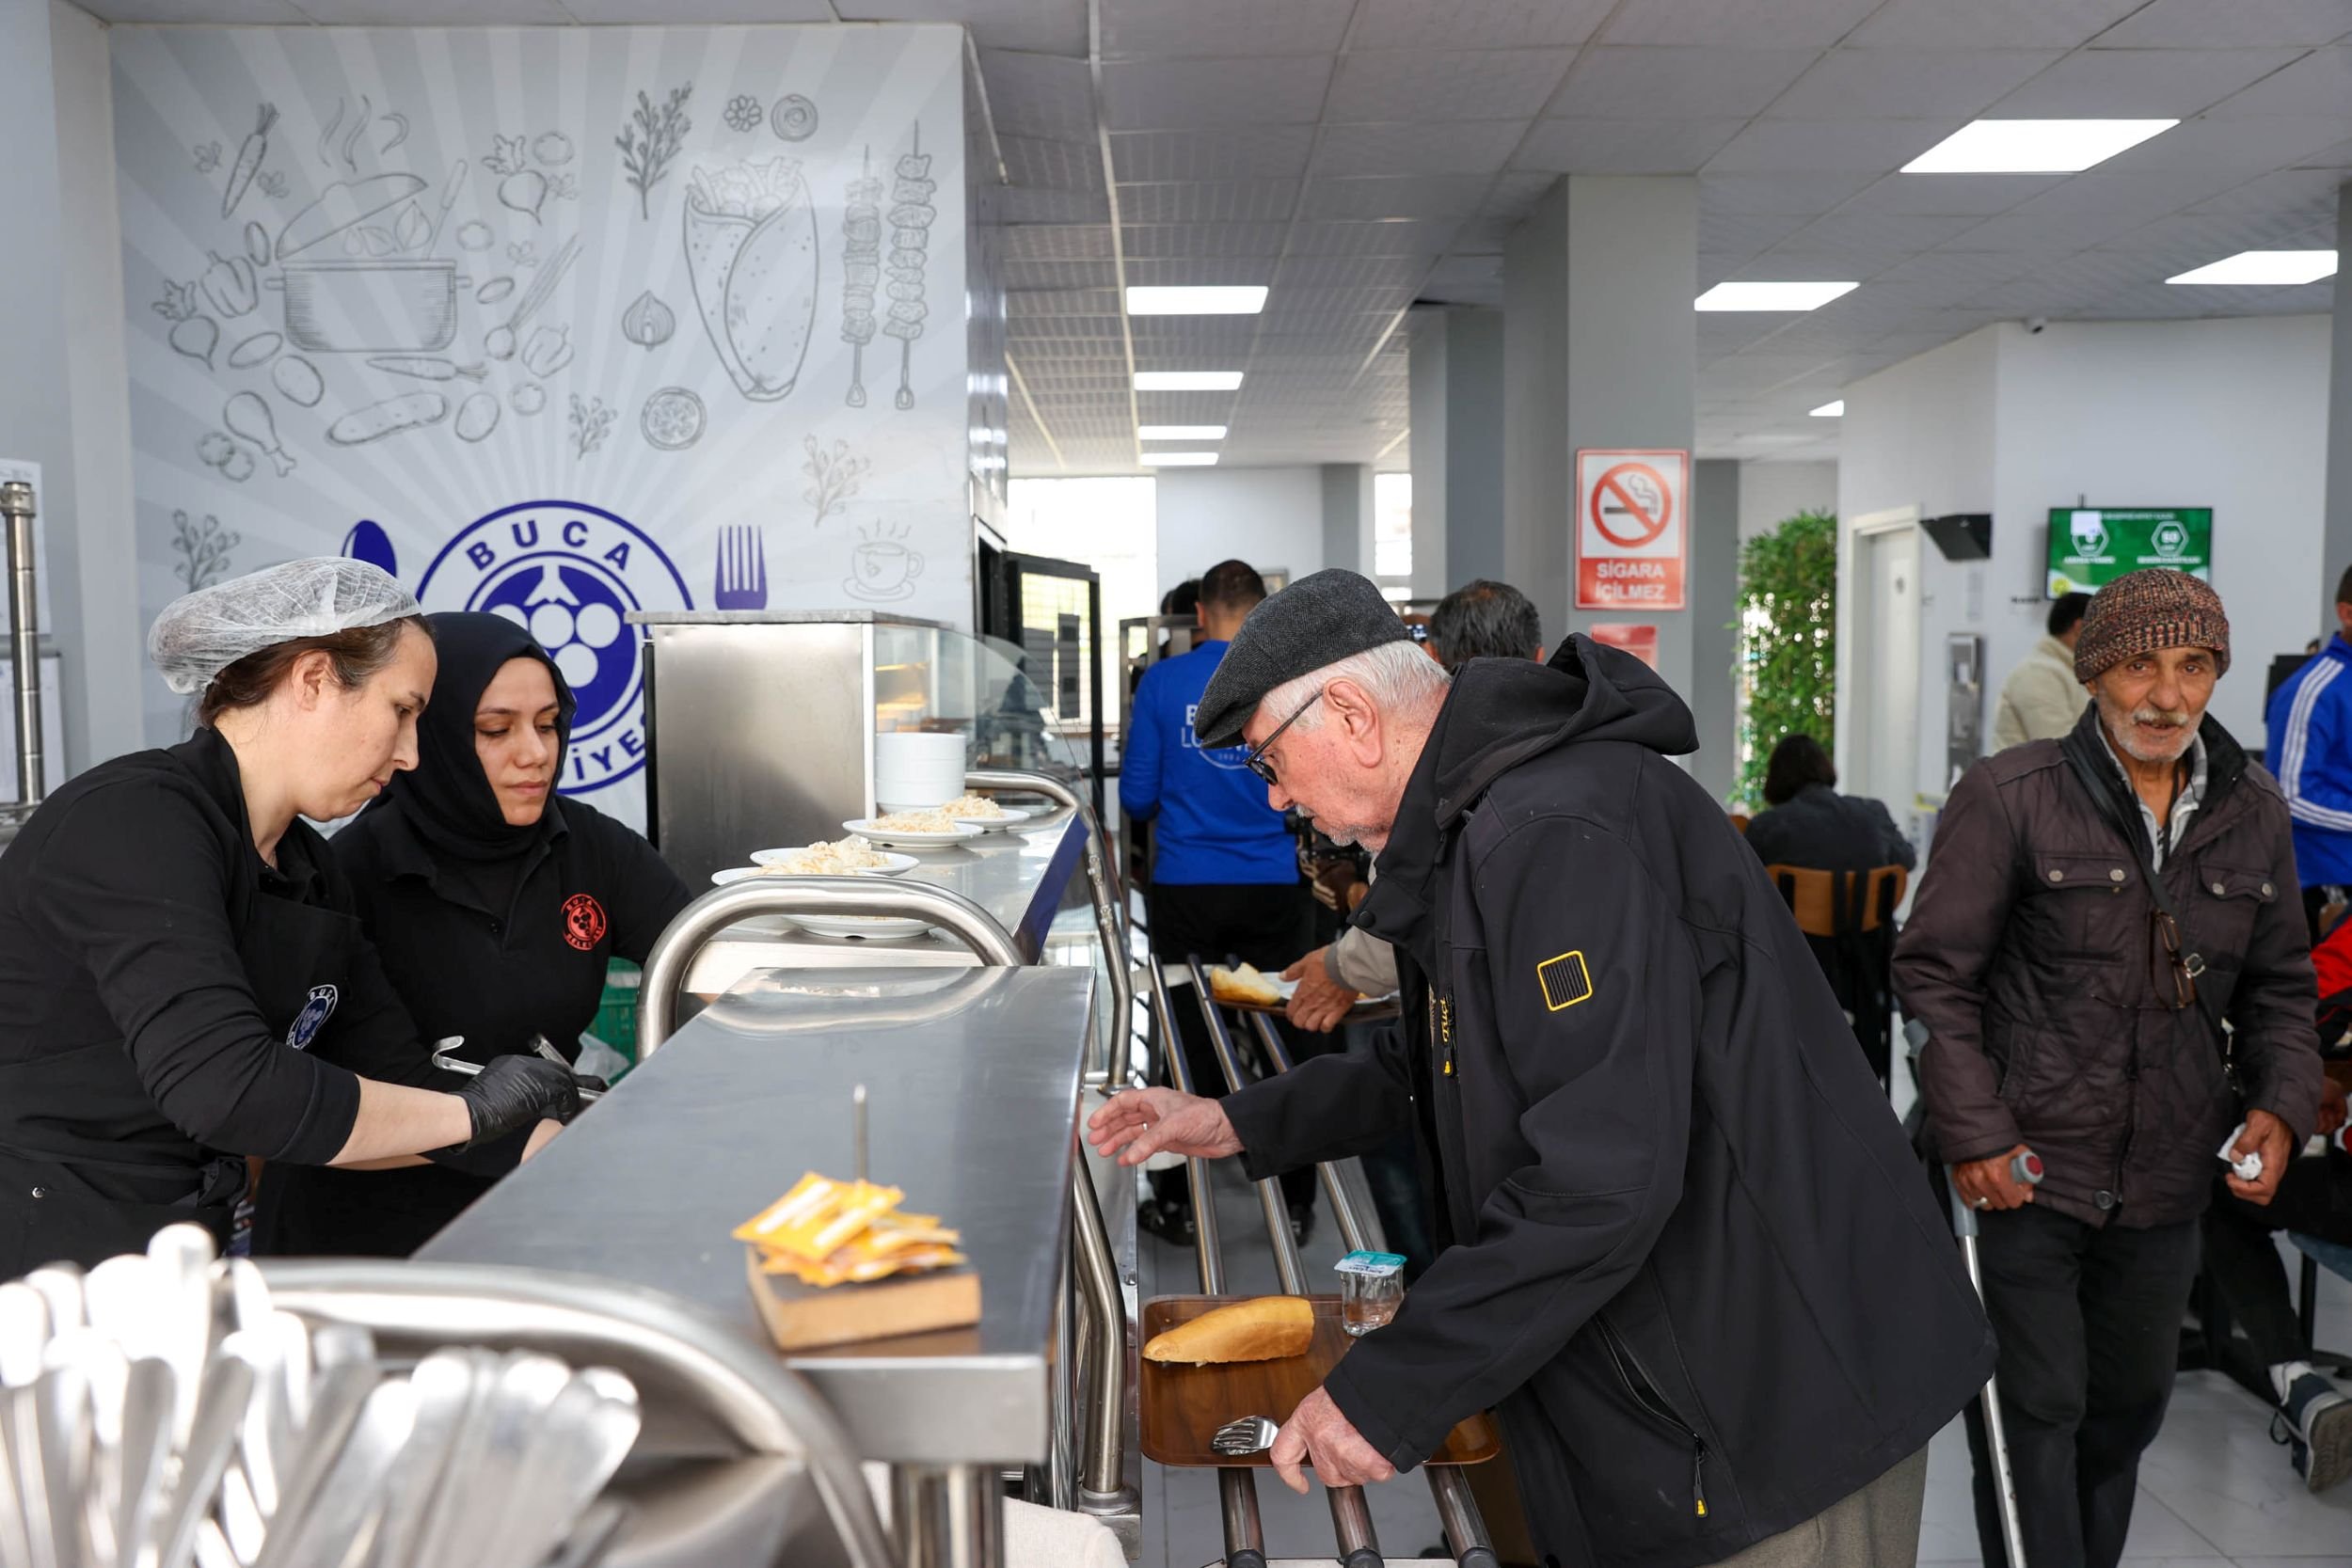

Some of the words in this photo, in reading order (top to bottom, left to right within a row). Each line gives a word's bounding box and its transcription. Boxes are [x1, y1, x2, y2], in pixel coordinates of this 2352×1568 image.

[467, 520, 630, 571] BUCA
[1597, 560, 1666, 578] SİGARA
[1595, 581, 1666, 601] İÇİLMEZ
